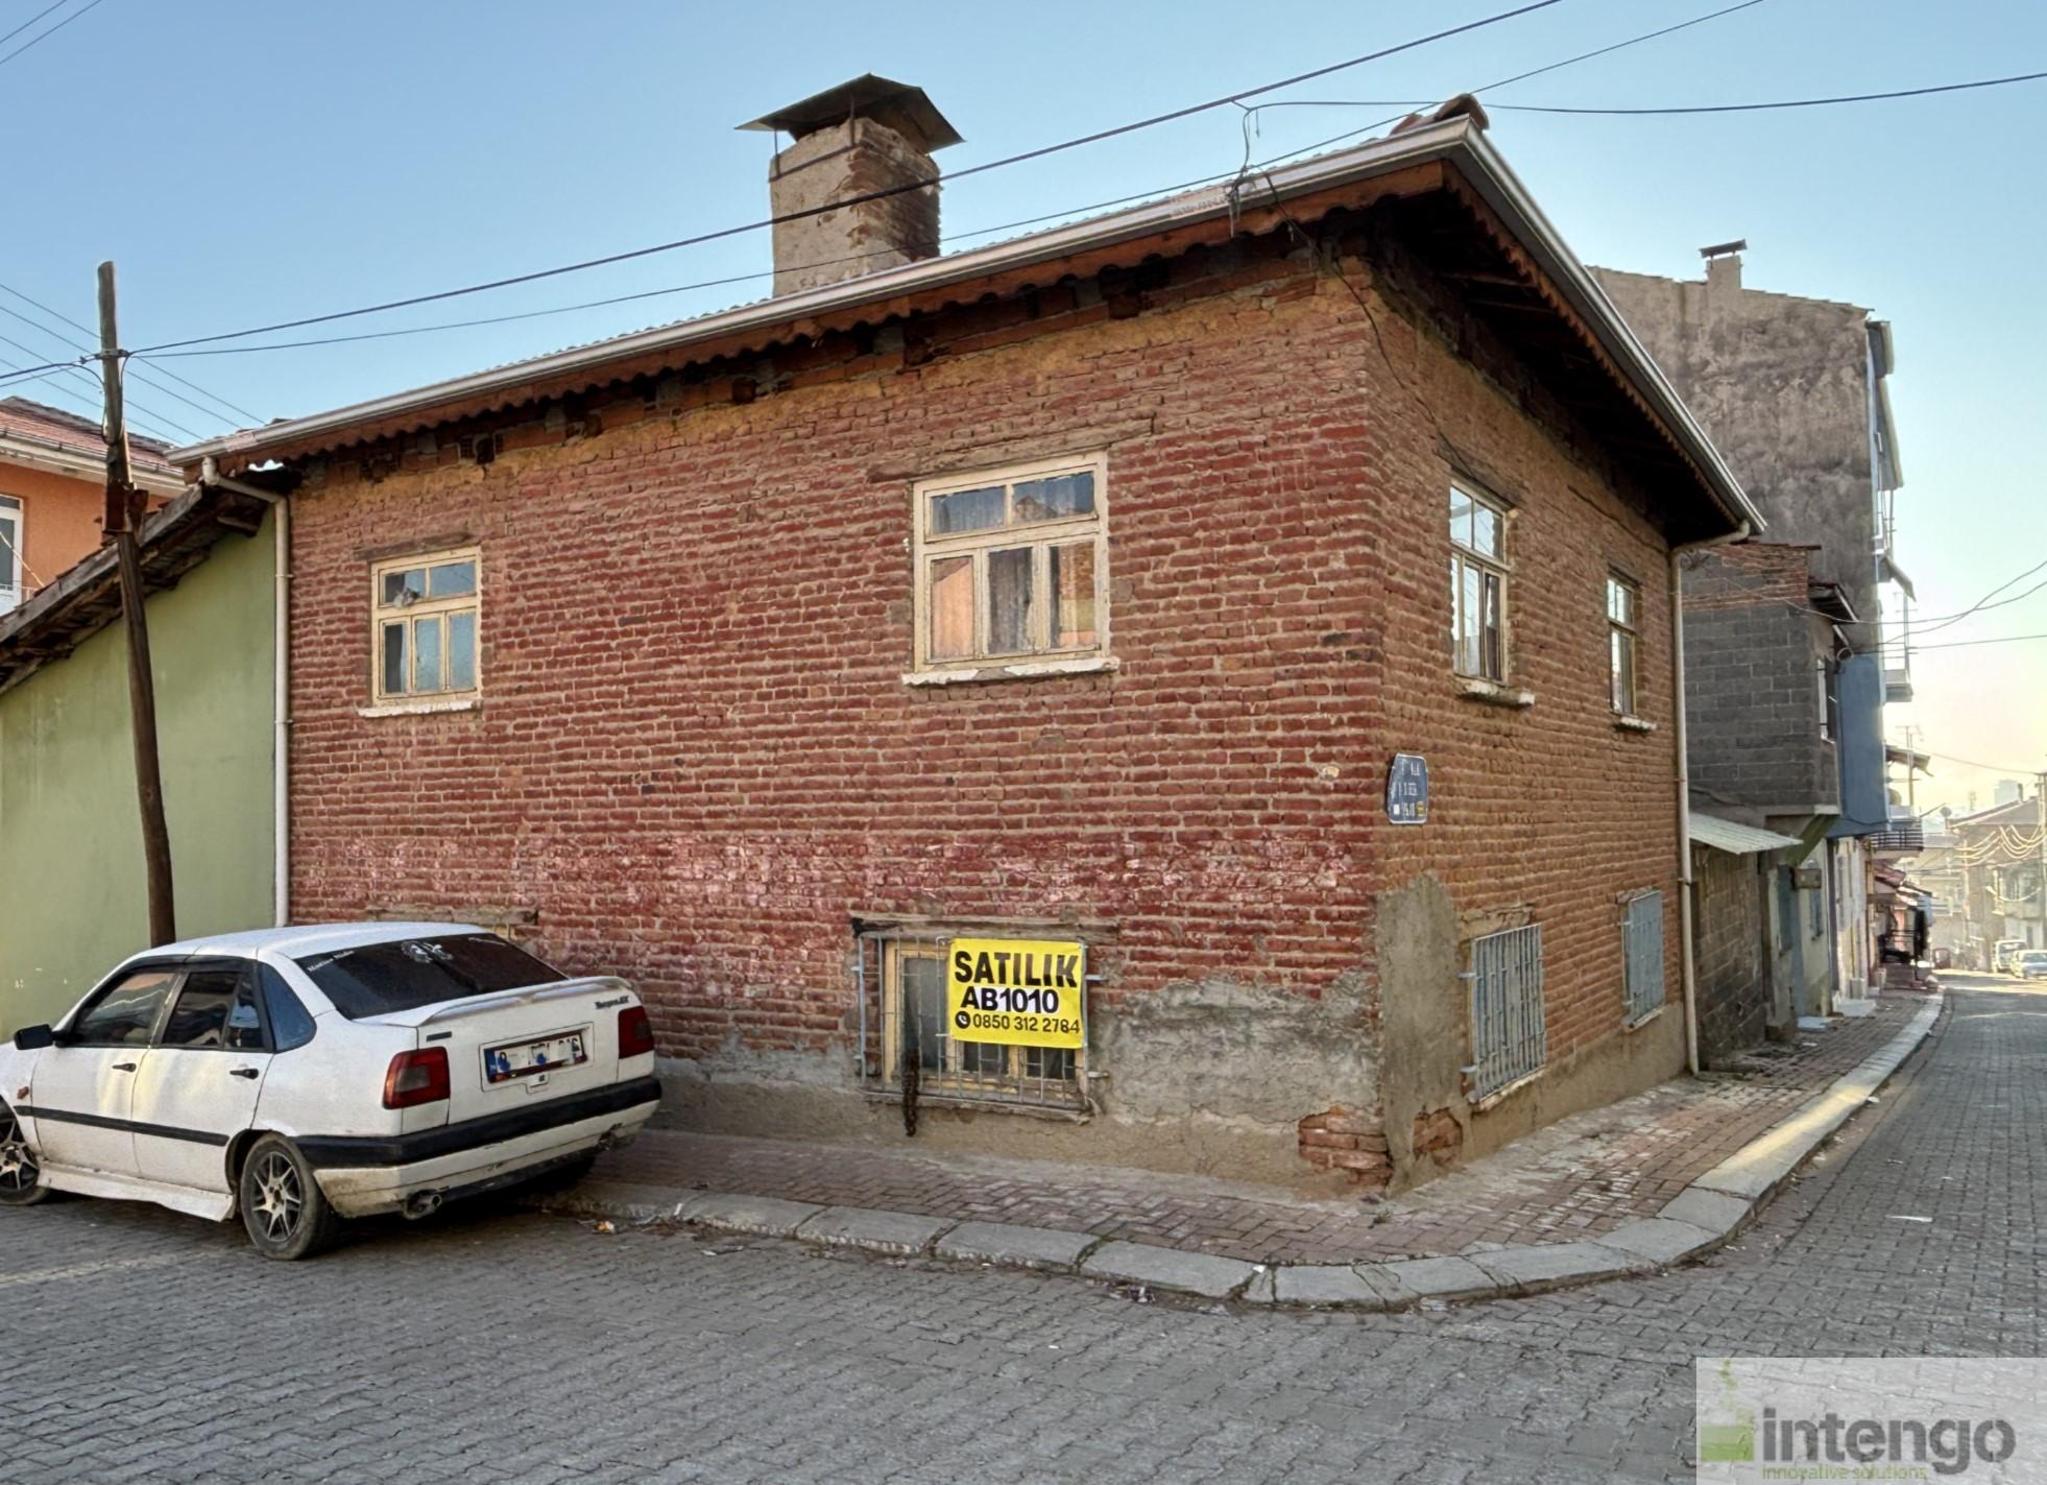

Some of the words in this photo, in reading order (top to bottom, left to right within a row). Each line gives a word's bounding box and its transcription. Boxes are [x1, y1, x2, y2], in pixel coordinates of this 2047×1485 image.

[954, 950, 1079, 988] SATILIK
[960, 985, 1060, 1014] AB1010
[972, 1013, 1011, 1030] 0850
[1014, 1016, 1039, 1032] 312
[1042, 1017, 1081, 1034] 2784
